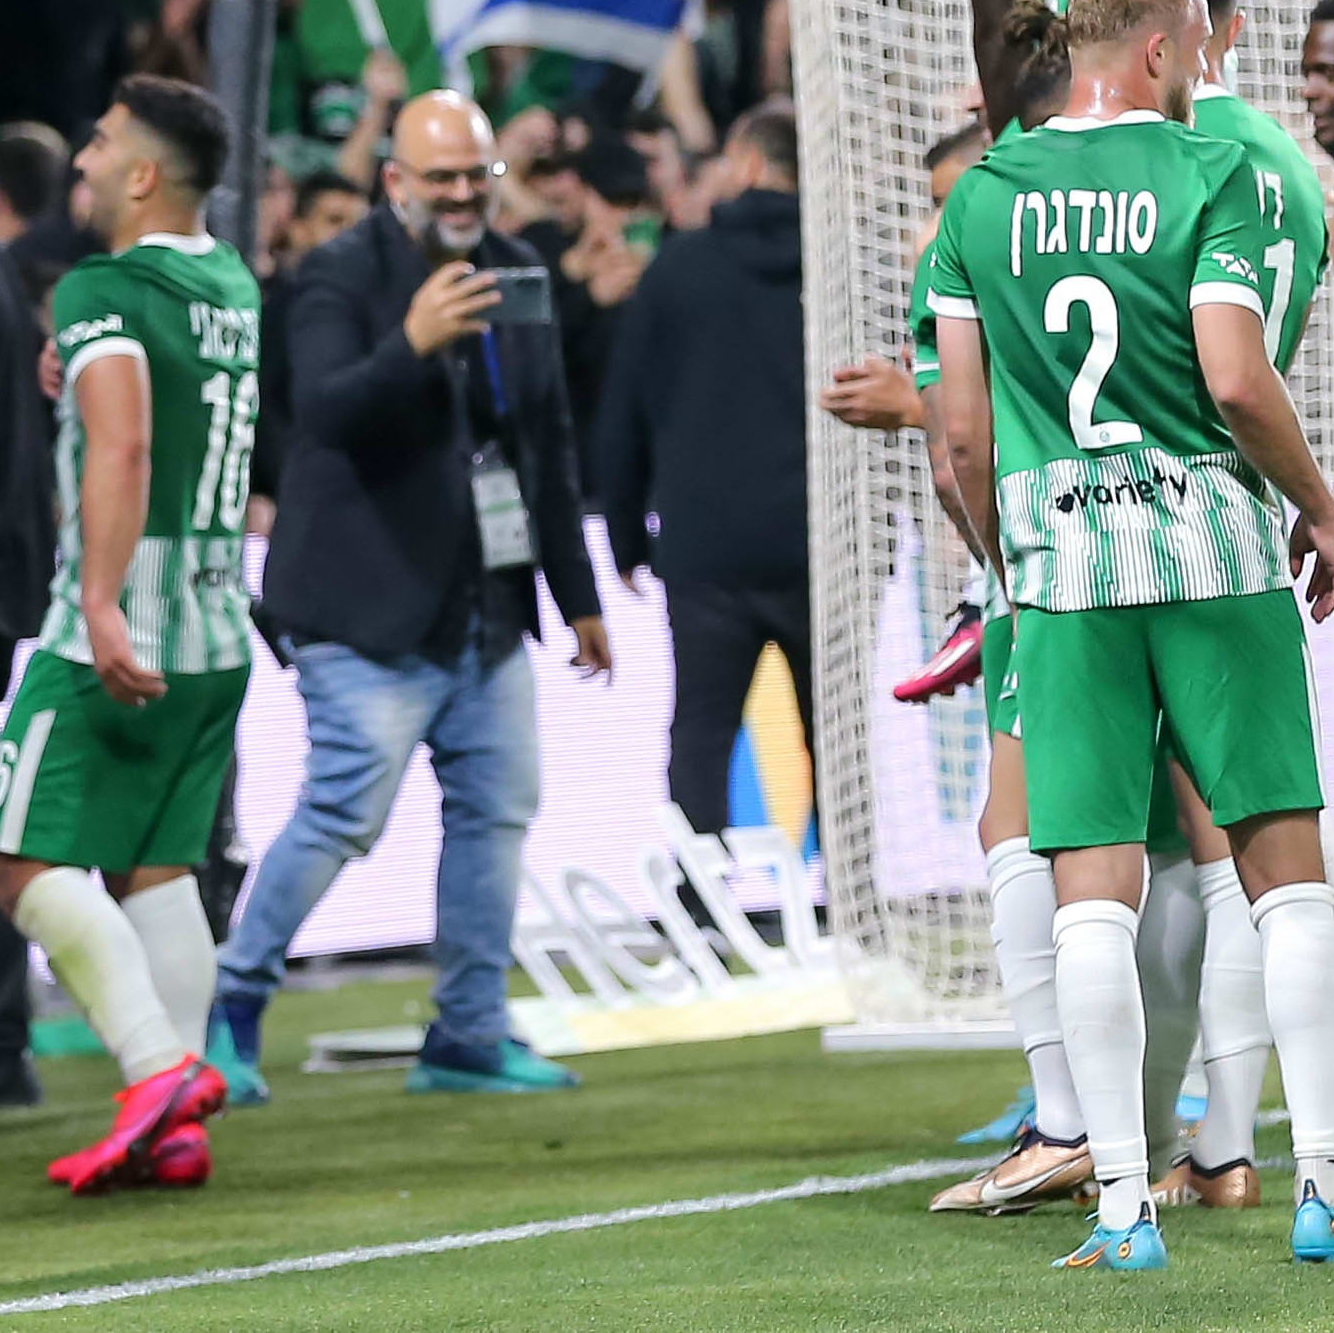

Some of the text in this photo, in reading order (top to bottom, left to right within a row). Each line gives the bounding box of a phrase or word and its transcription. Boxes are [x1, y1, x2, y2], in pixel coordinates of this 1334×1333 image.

[1009, 188, 1159, 279] סונדגרן
[1043, 275, 1144, 450] 2
[1073, 467, 1187, 508] variety
